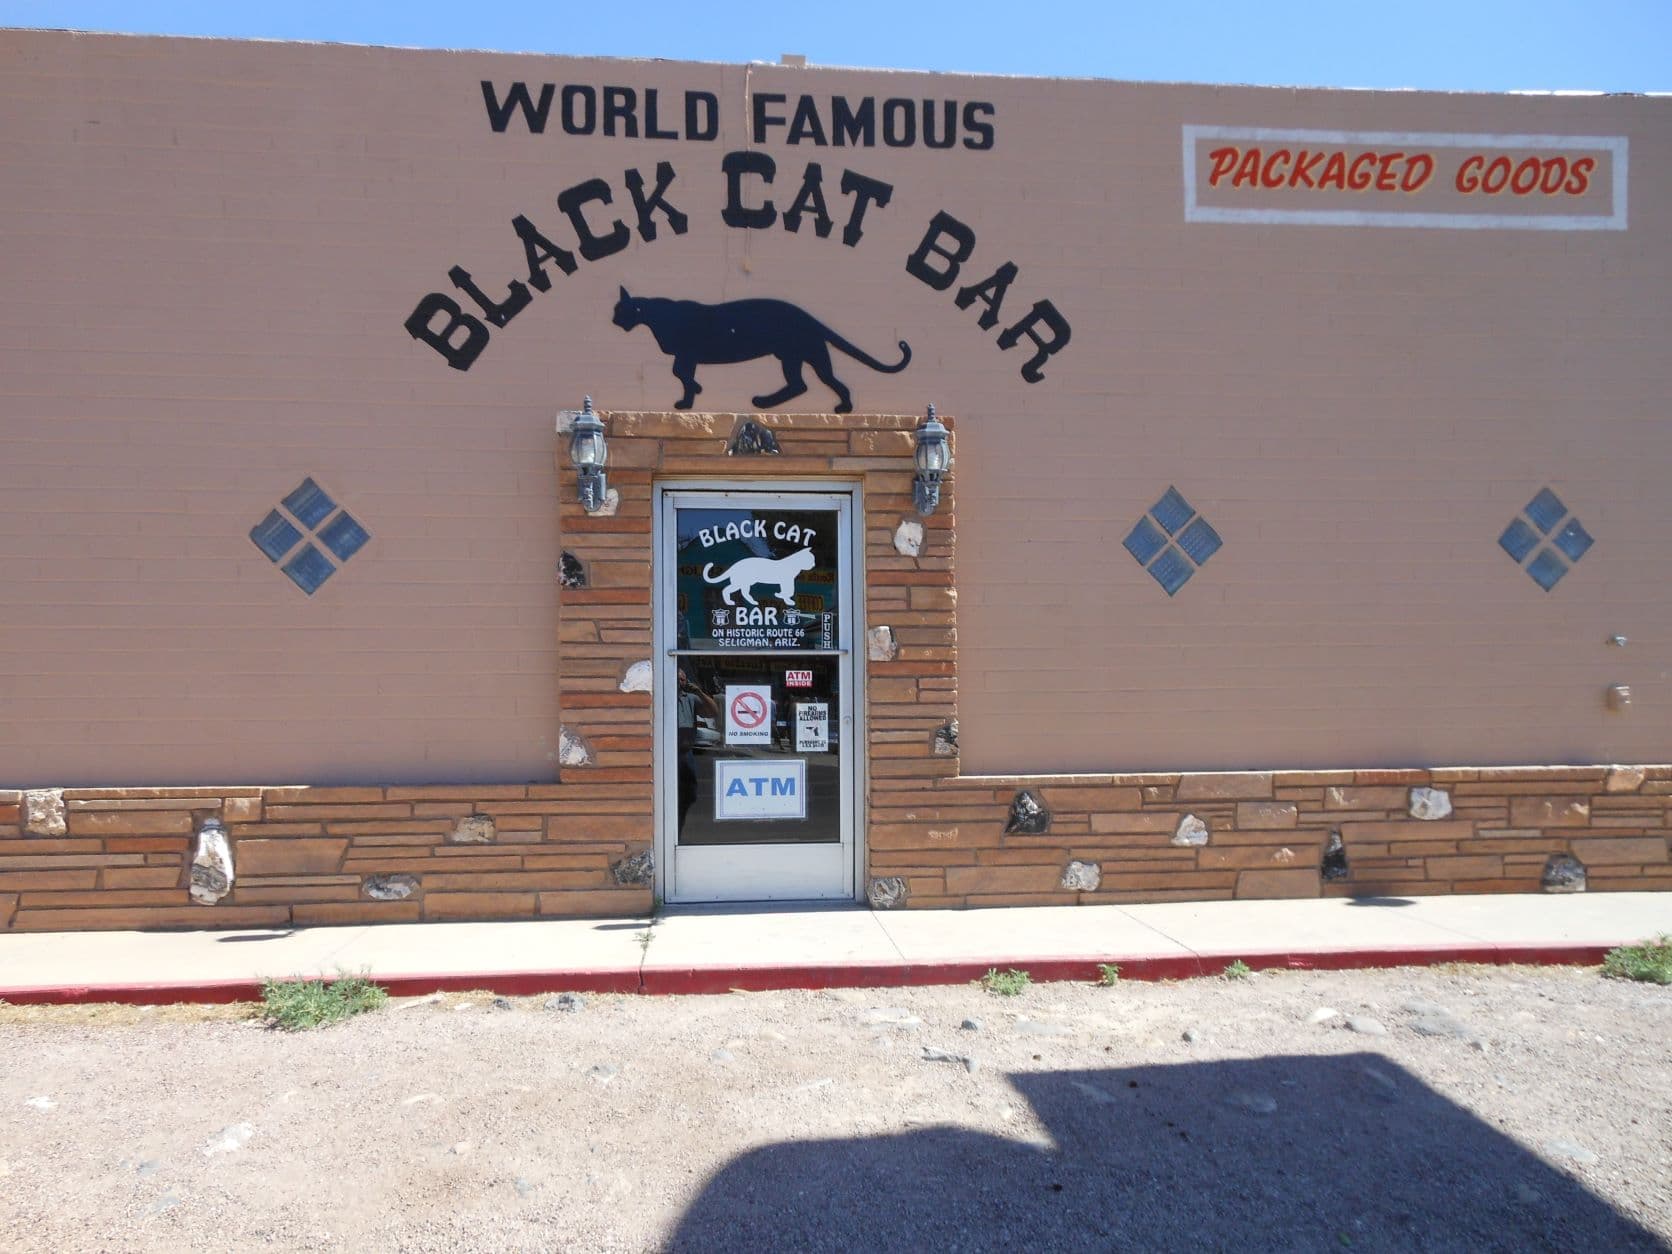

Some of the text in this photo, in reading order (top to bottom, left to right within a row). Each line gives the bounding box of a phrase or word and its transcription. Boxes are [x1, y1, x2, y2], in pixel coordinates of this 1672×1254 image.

[480, 80, 995, 150] WORLD FAMOUS
[1208, 146, 1595, 195] PACKAGED GOODS
[404, 151, 1072, 383] BLACK CAT BAR
[699, 519, 816, 548] BLACK CAT
[735, 606, 778, 626] BAR
[711, 628, 805, 638] ON HISTORIC ROUTE 66
[718, 638, 801, 647] SELIGMAN, ARIZ.
[823, 613, 831, 649] PUSH
[787, 671, 811, 680] ATM
[726, 777, 796, 796] ATM
